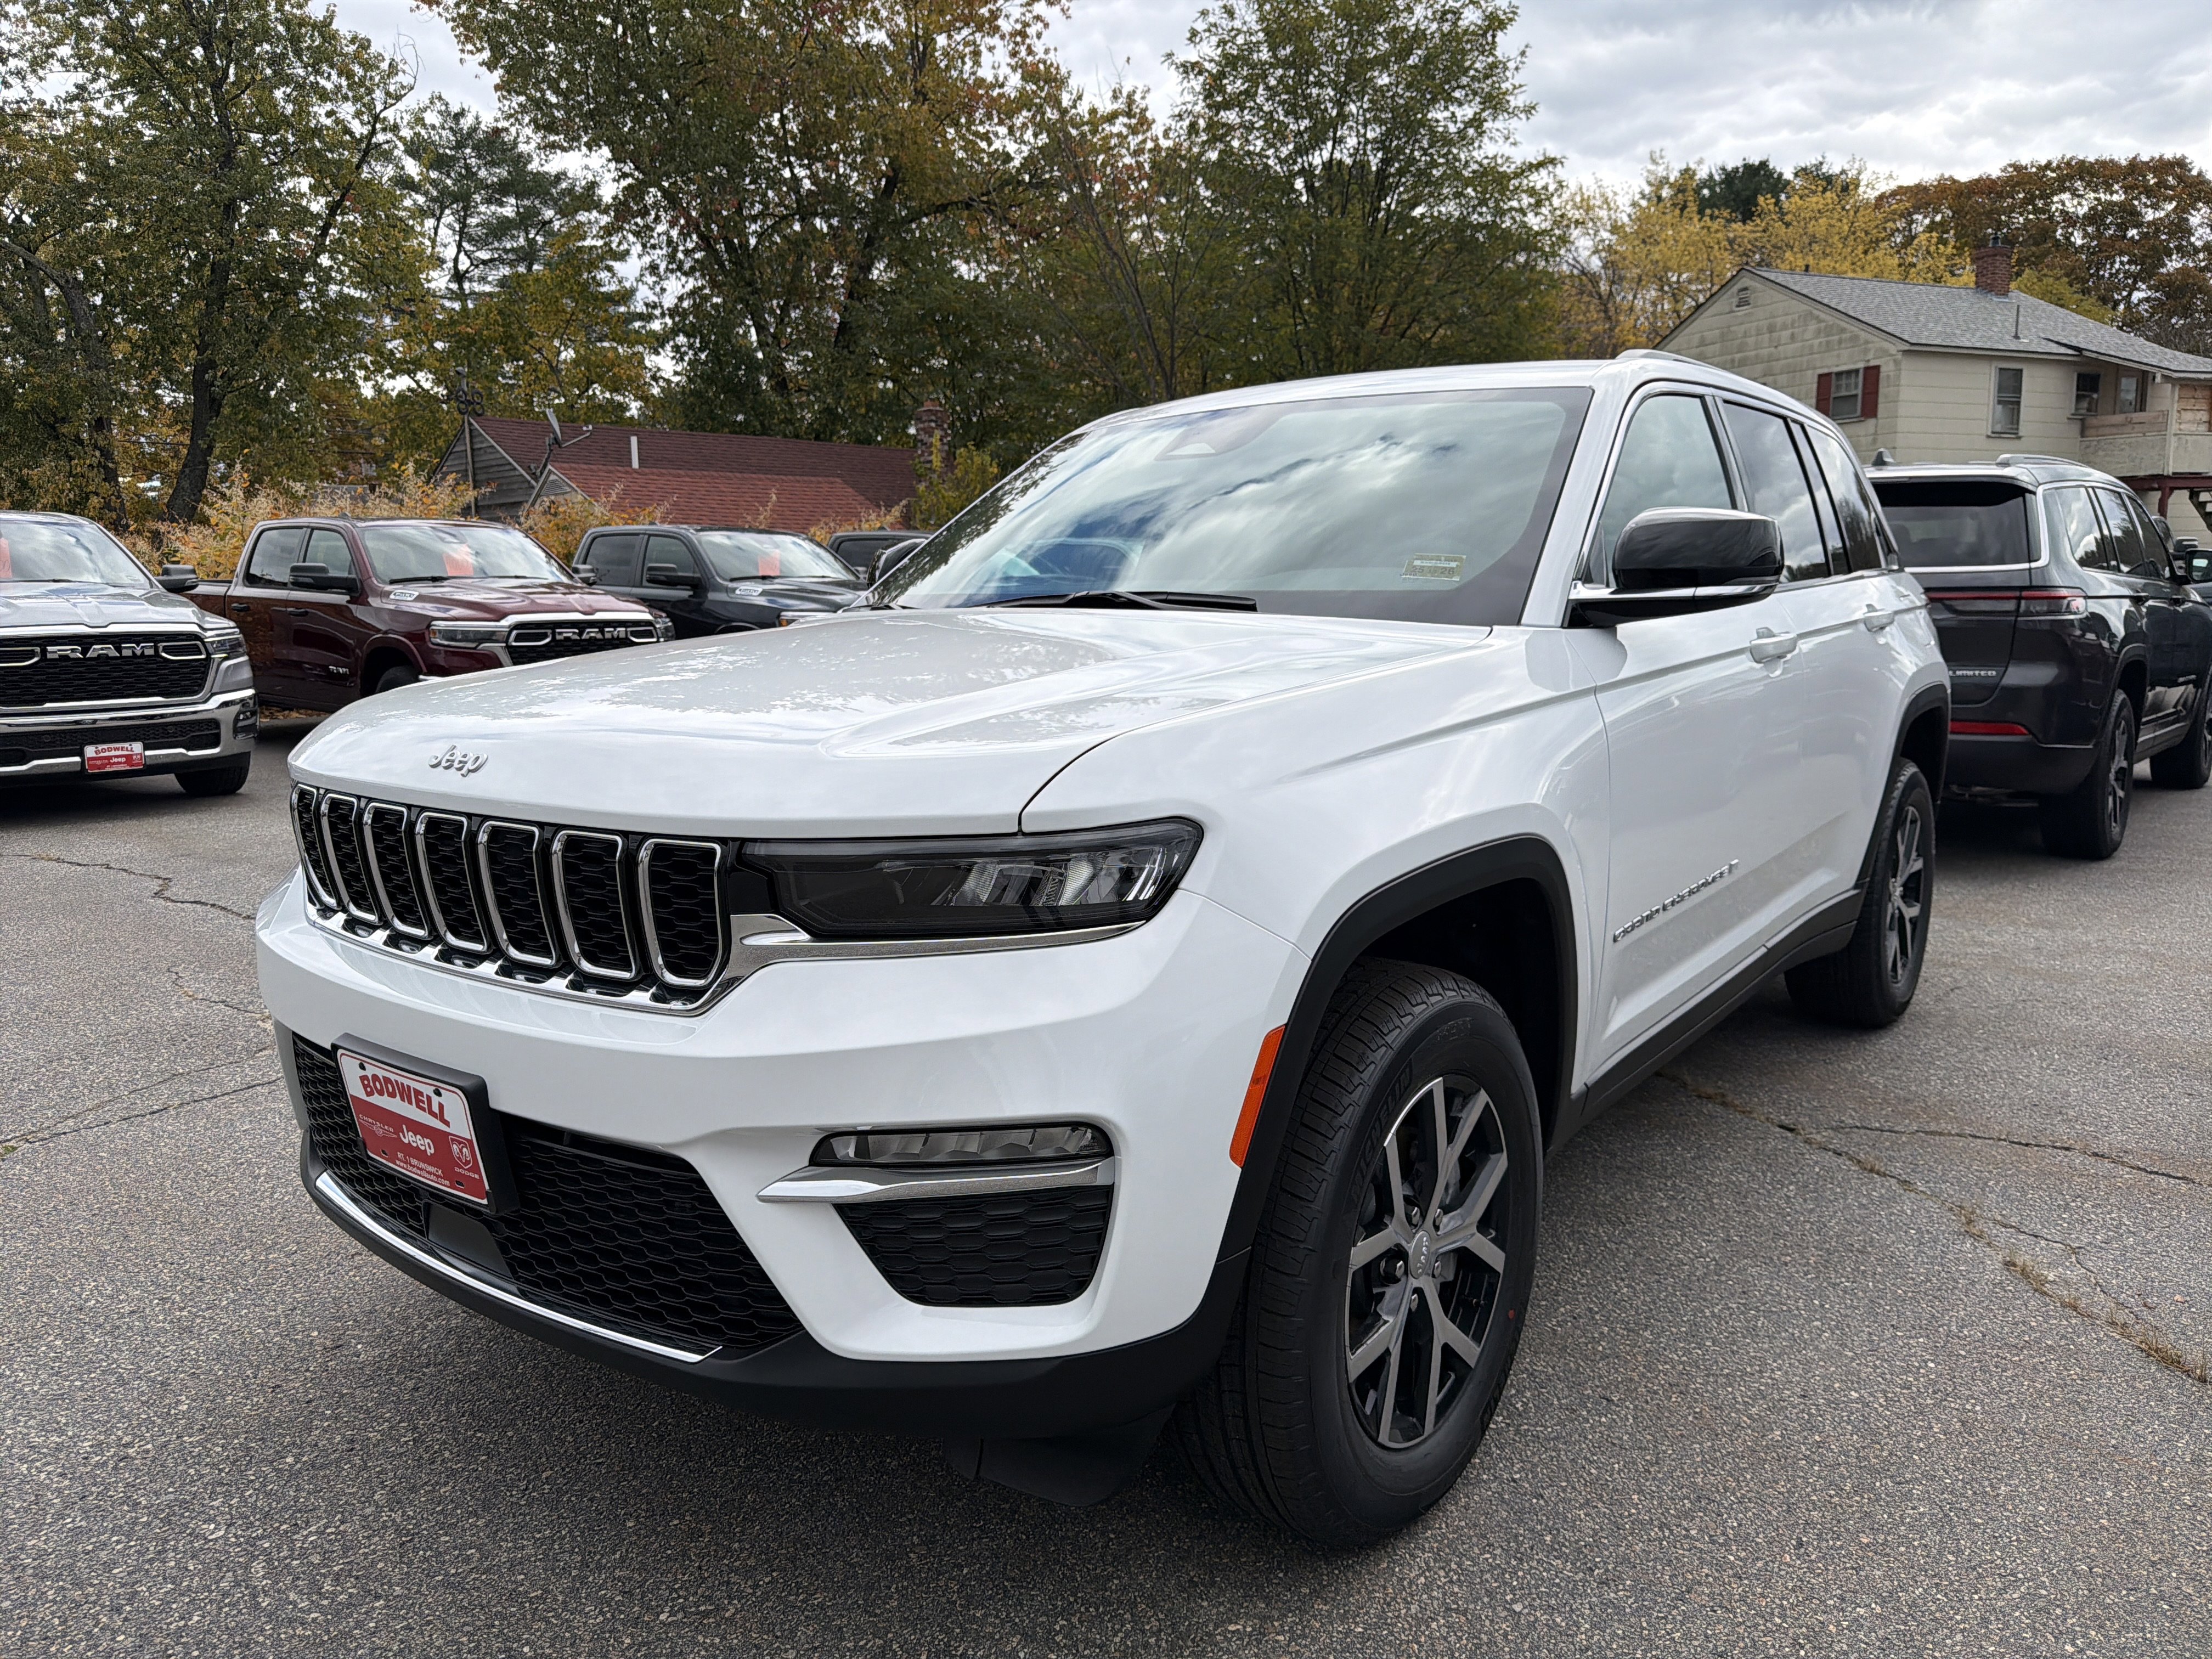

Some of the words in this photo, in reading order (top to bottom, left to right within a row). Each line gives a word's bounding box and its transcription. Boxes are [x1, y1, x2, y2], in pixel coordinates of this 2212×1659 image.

[556, 627, 626, 640] RAM
[46, 643, 155, 658] RAM
[94, 746, 135, 755] BODWELL
[428, 744, 488, 778] Jeep
[359, 1073, 451, 1129] BODWELL
[359, 1114, 394, 1133] CHRYSLER
[1350, 1058, 1413, 1205] MICHELIN
[399, 1124, 435, 1156] Jeep
[395, 1159, 450, 1187] www.bodwellauto.com
[397, 1152, 406, 1161] RT.
[411, 1158, 444, 1177] BRUNSWICK
[454, 1166, 480, 1180] DODGE
